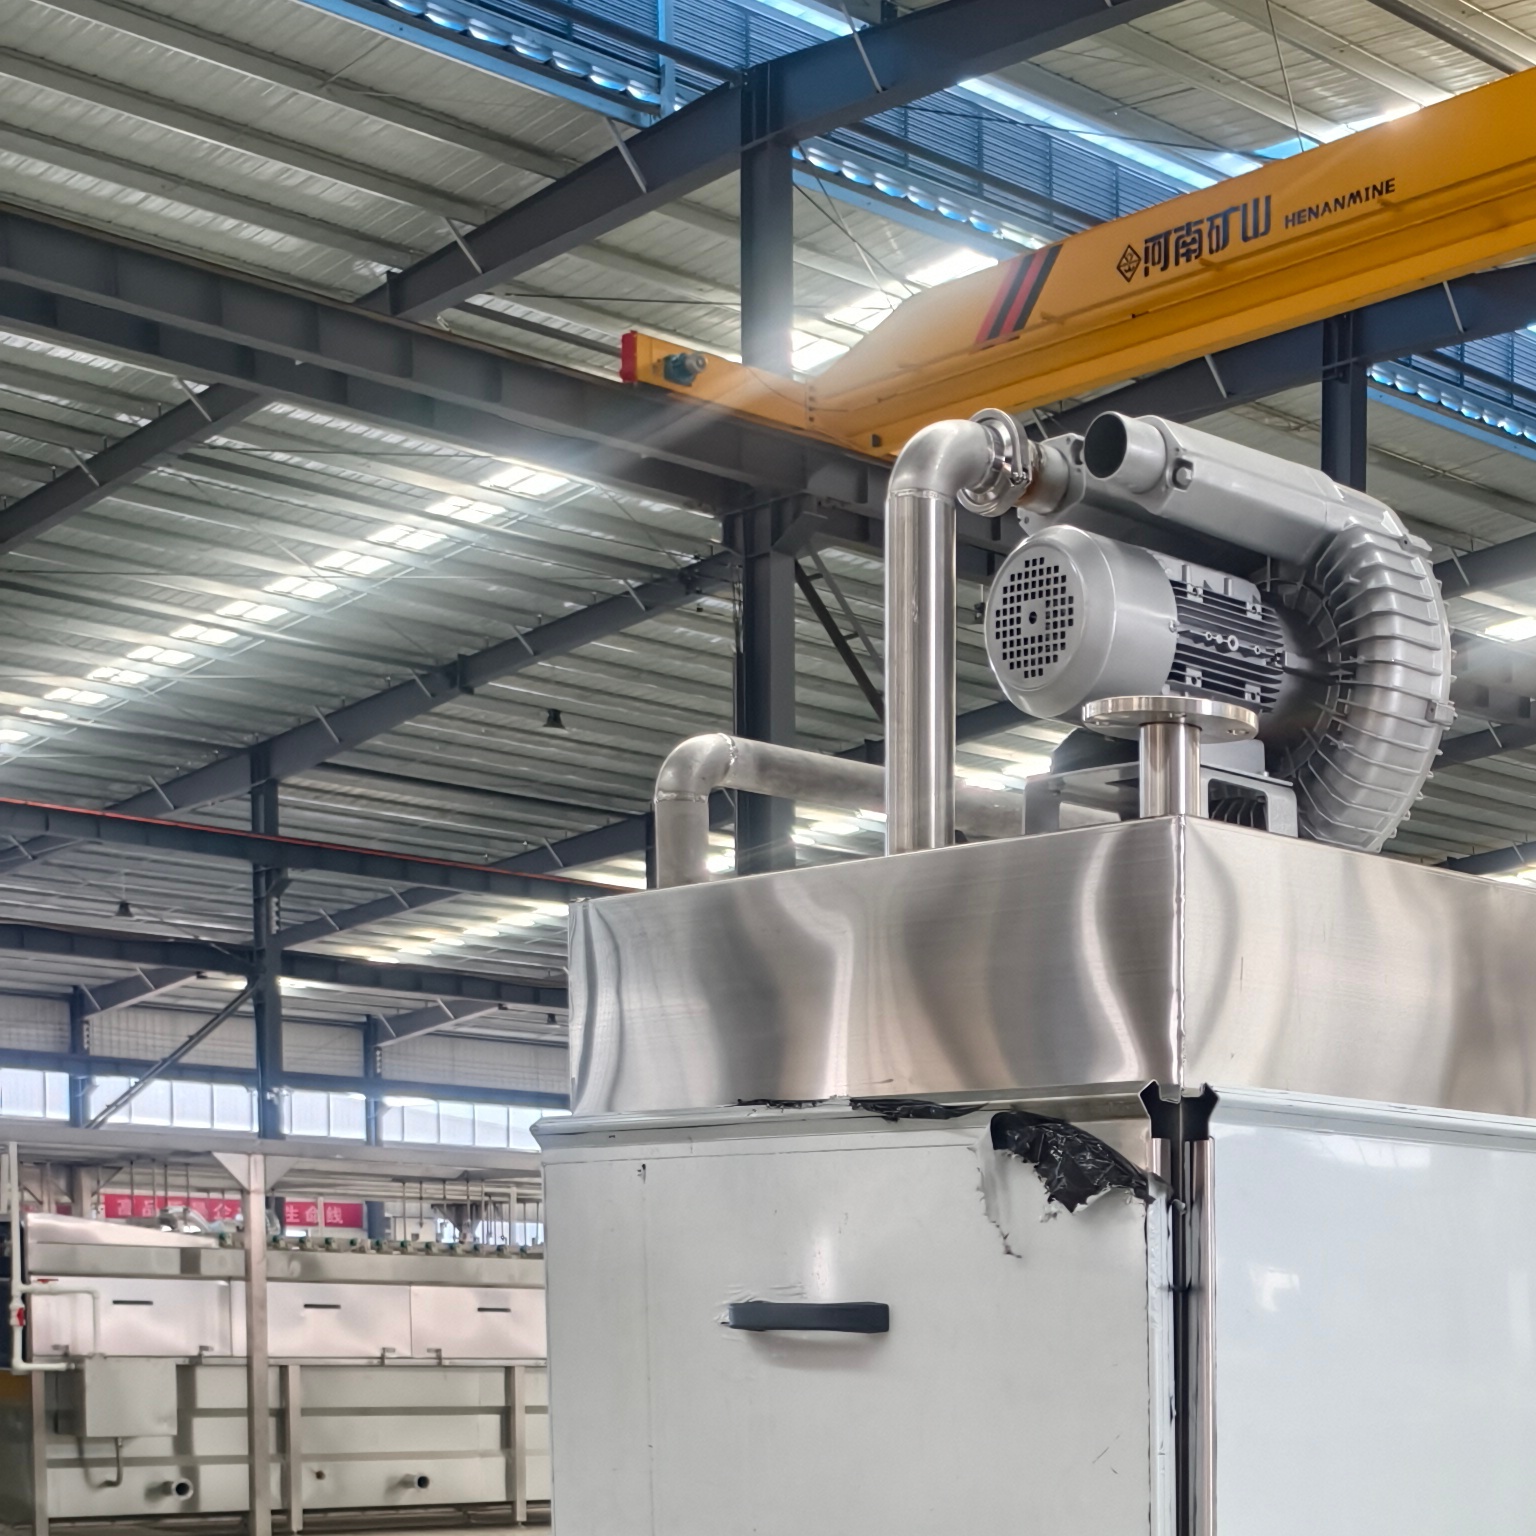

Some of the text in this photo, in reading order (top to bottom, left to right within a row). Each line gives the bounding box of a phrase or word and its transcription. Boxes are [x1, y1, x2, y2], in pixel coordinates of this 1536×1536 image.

[1143, 195, 1271, 277] 河南矿山
[1284, 178, 1395, 229] HENANMINE
